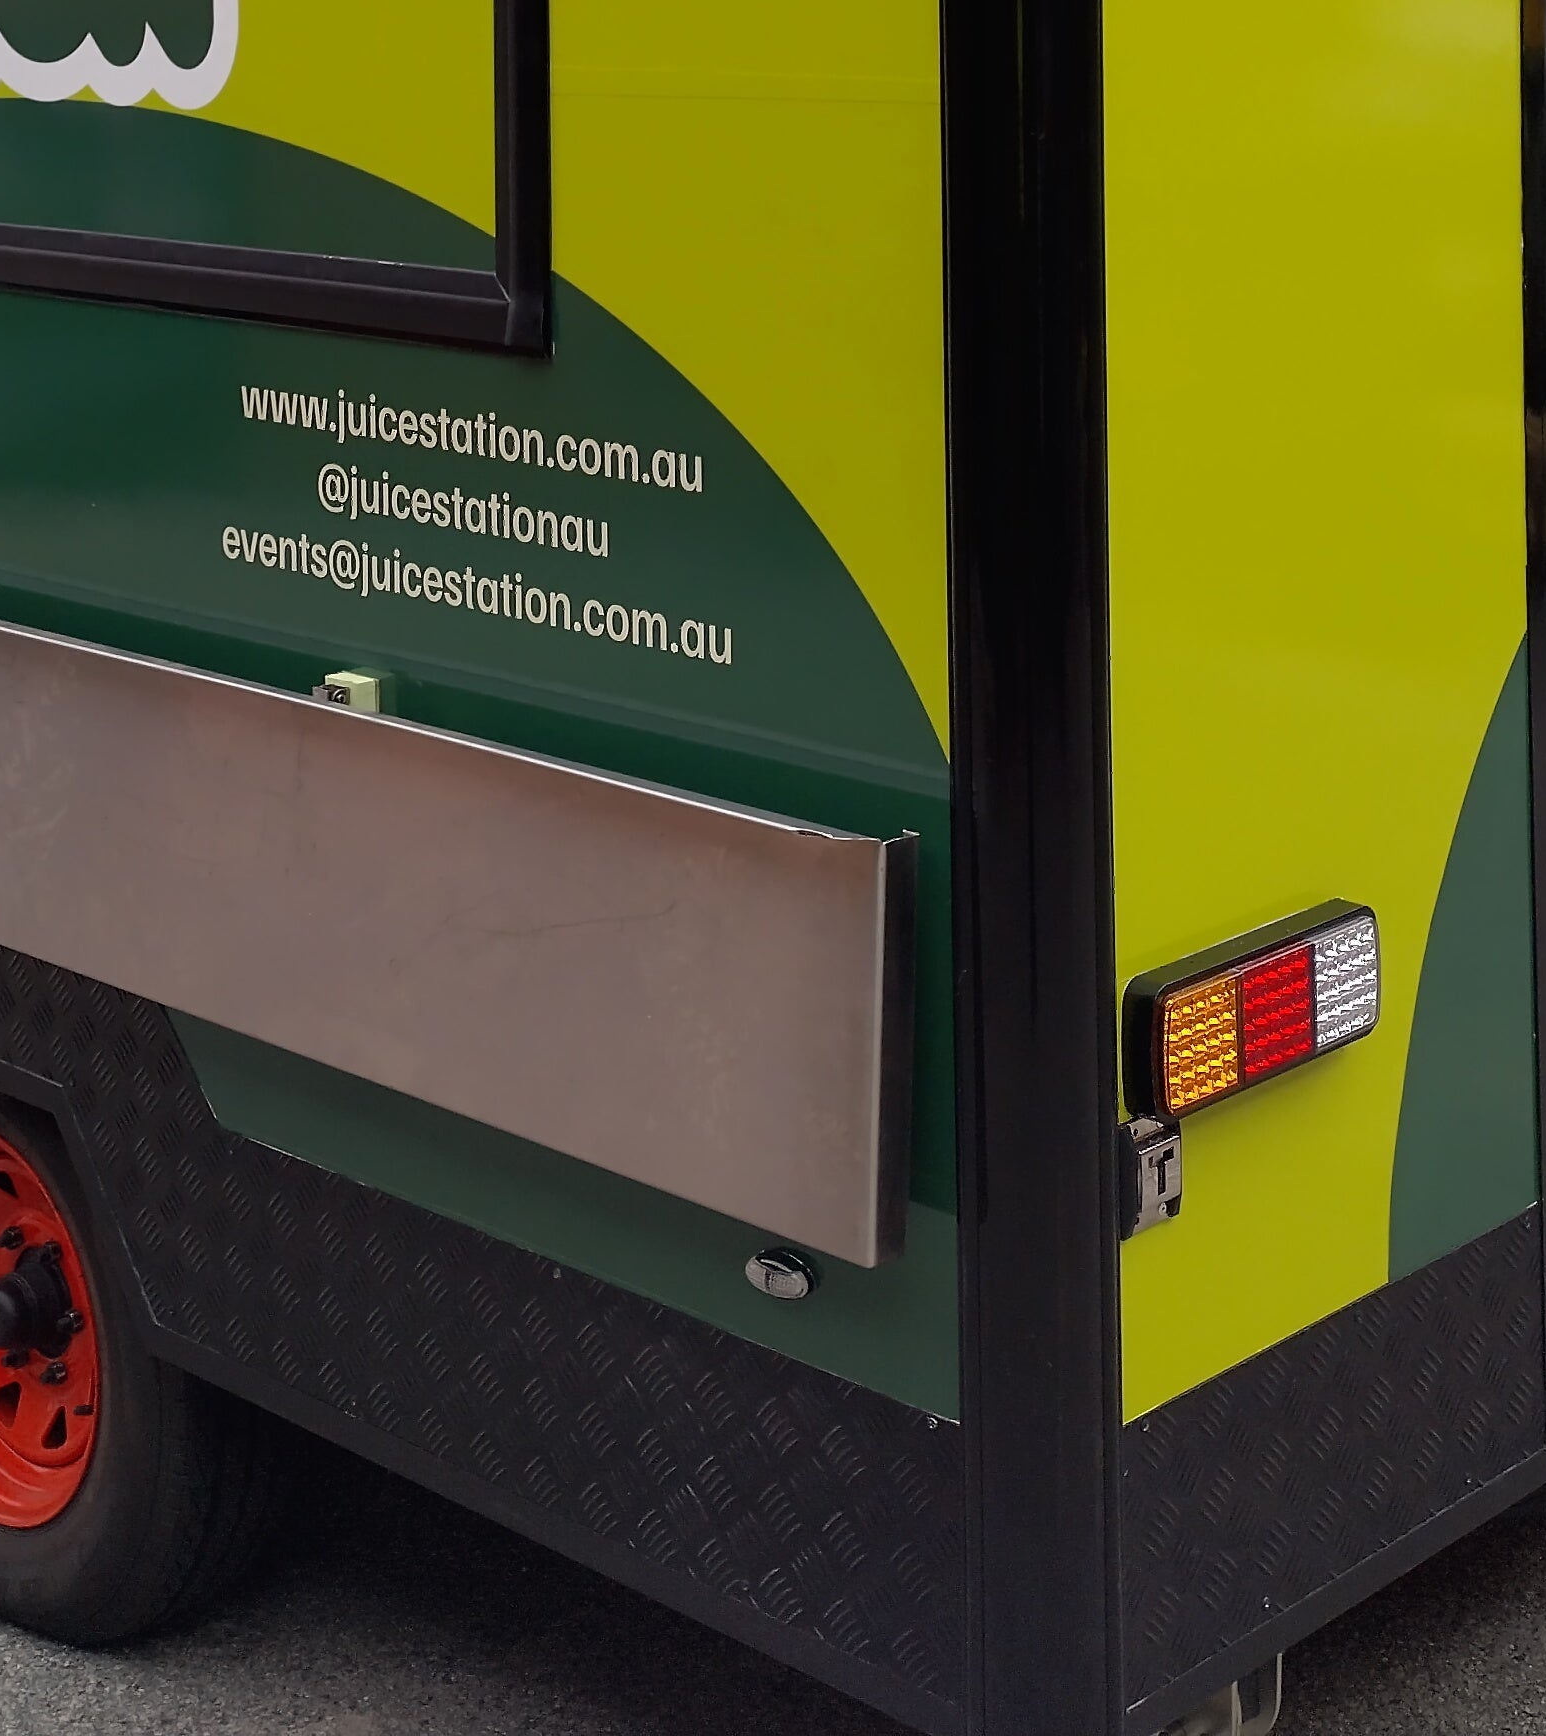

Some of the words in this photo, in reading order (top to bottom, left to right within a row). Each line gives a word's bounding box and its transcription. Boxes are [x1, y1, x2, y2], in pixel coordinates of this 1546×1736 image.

[240, 384, 704, 493] www.juicestation.com.au
[317, 462, 610, 558] @juicestationau
[222, 524, 733, 665] events@juicestation.com.au
